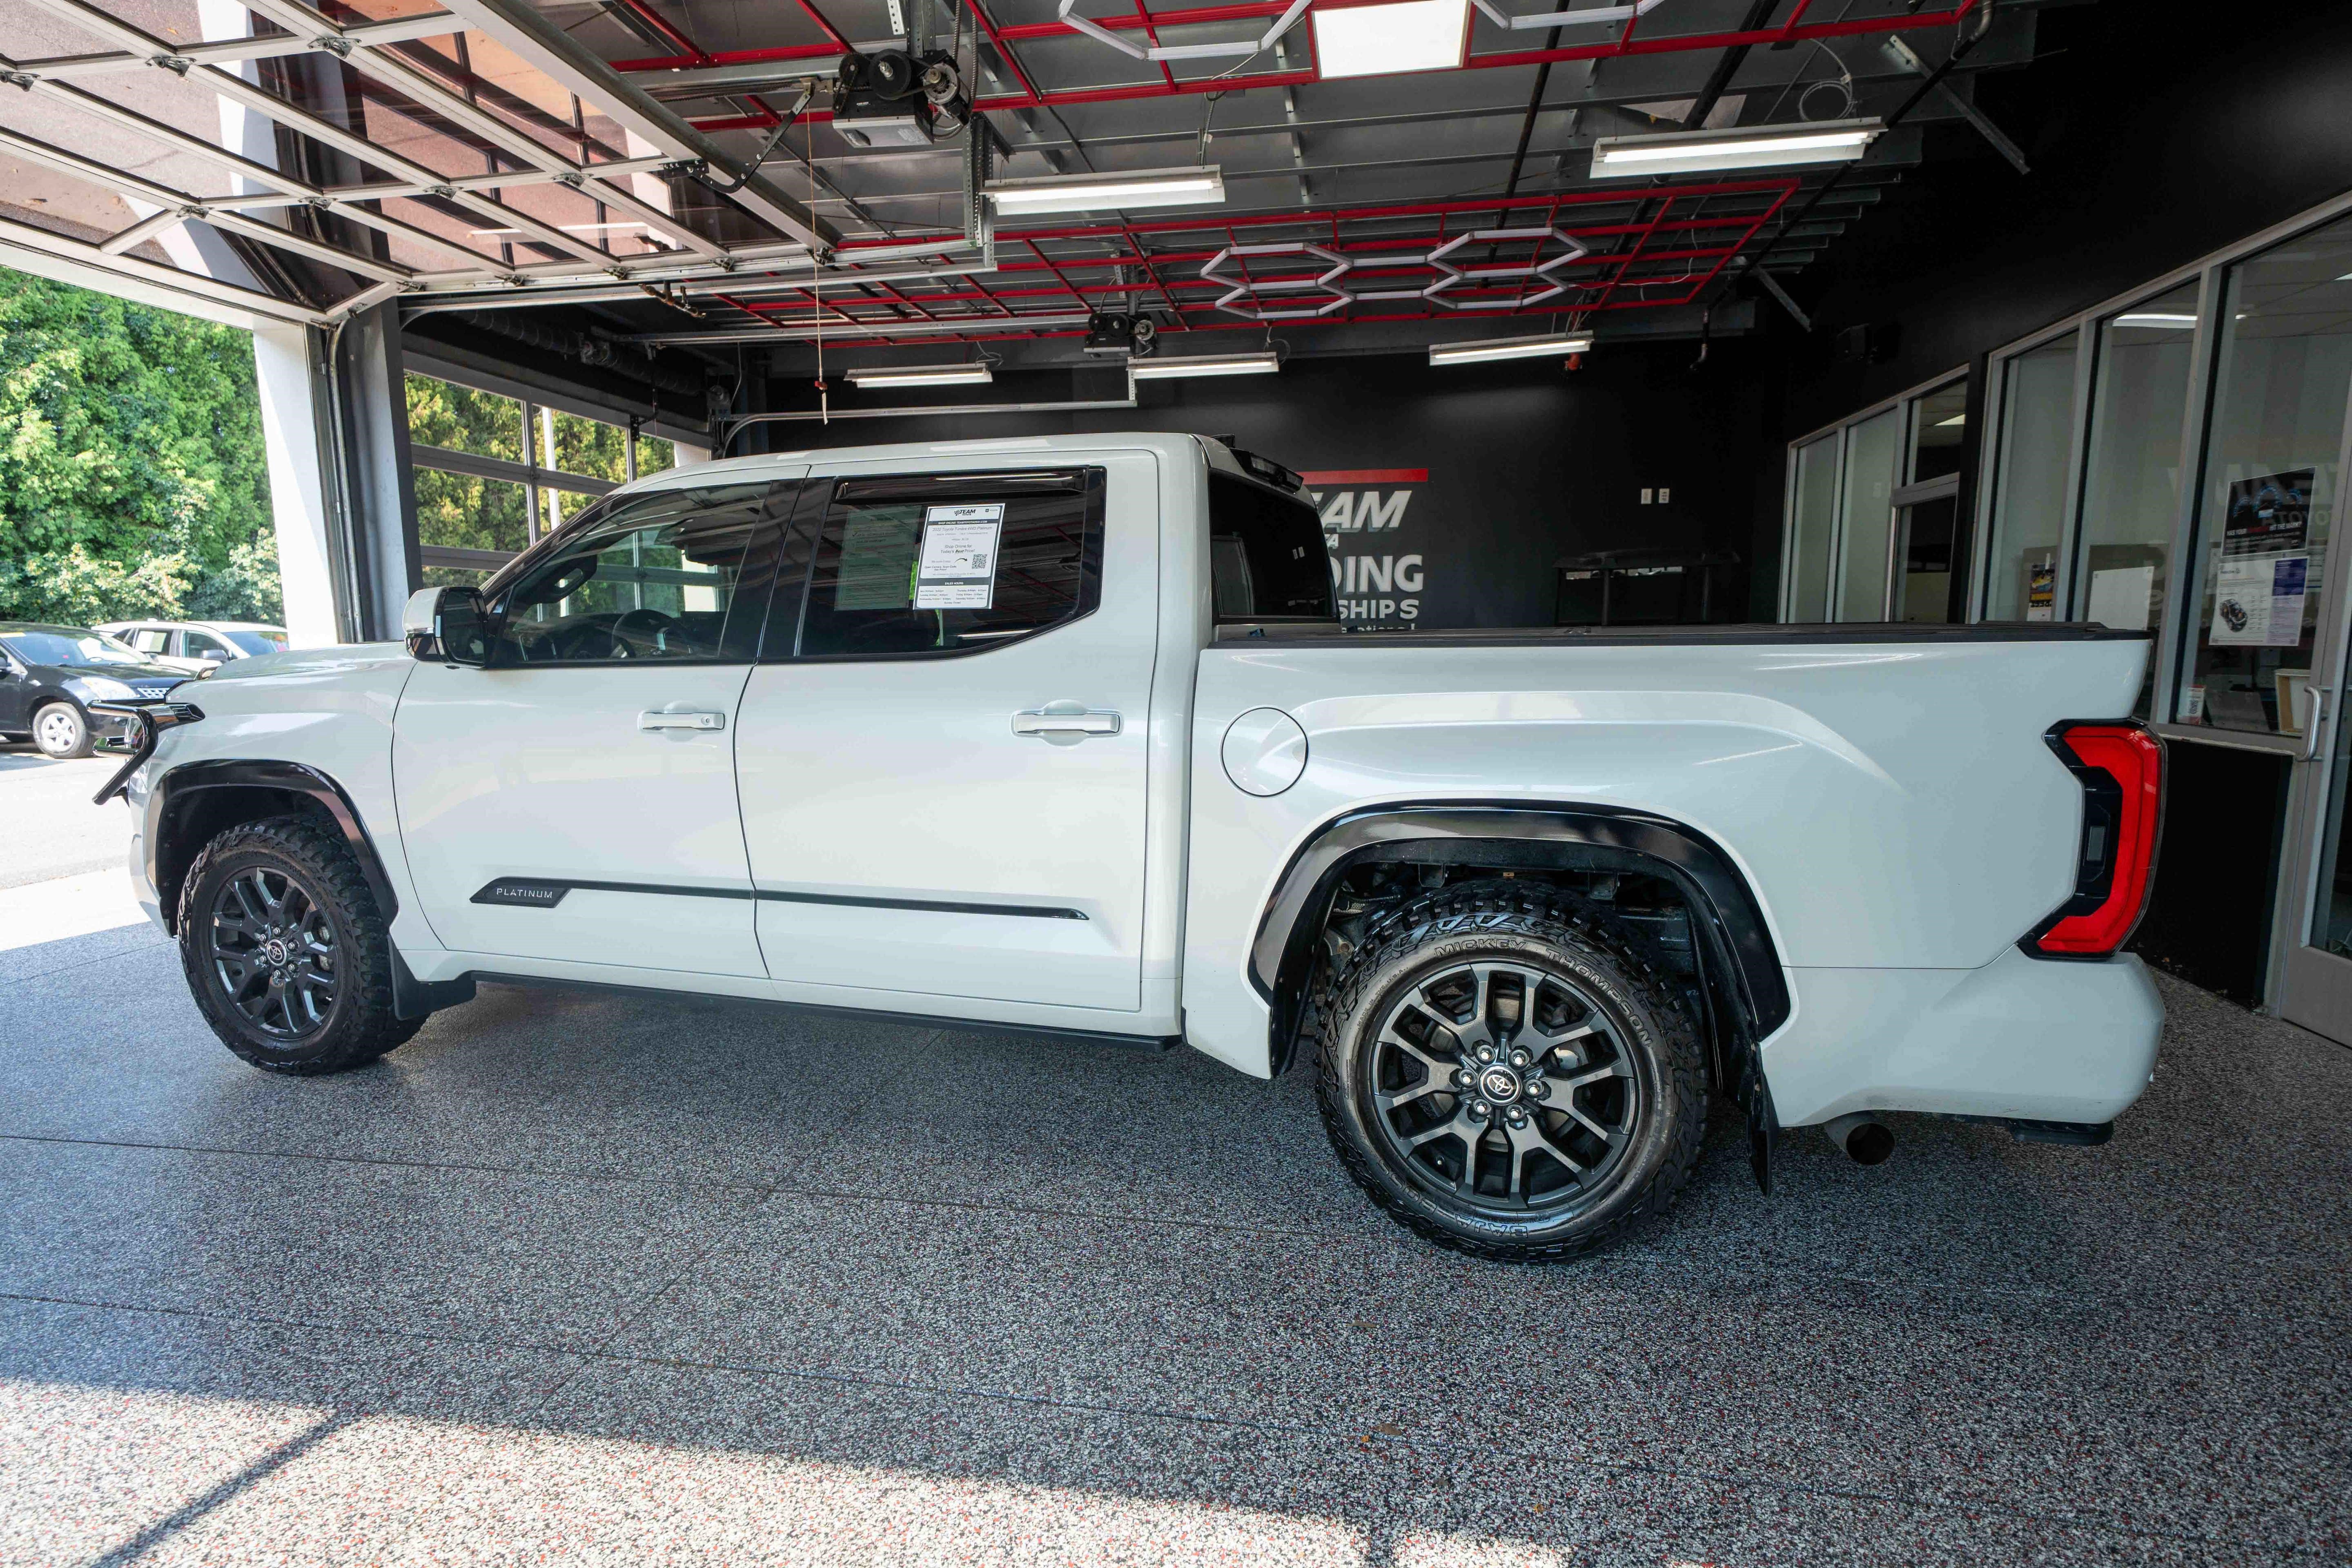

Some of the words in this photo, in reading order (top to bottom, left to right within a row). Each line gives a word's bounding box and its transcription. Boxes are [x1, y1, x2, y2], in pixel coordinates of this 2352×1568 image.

[497, 888, 552, 899] PLATINUM
[1434, 938, 1527, 958] MICKEY
[1546, 948, 1654, 1047] THOMPSON
[1375, 1158, 1438, 1215] BOSS
[1455, 1213, 1529, 1238] BAJA
